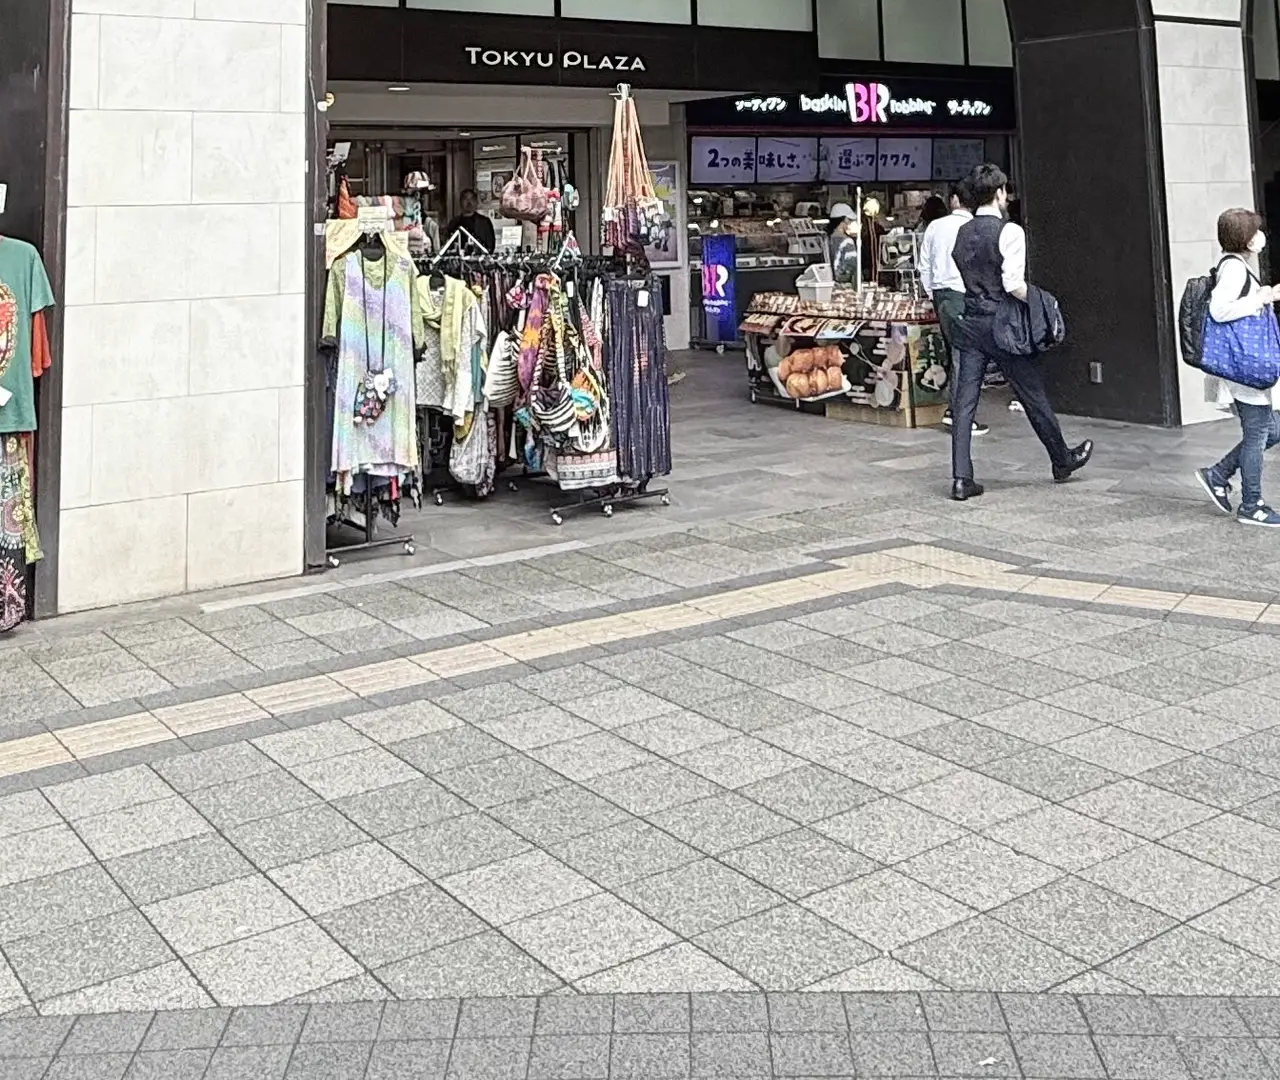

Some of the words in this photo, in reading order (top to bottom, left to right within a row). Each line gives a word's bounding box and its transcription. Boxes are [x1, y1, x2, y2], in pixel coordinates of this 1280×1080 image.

[465, 46, 553, 68] TOKYU
[563, 51, 646, 71] PLAZA
[845, 82, 890, 123] BR
